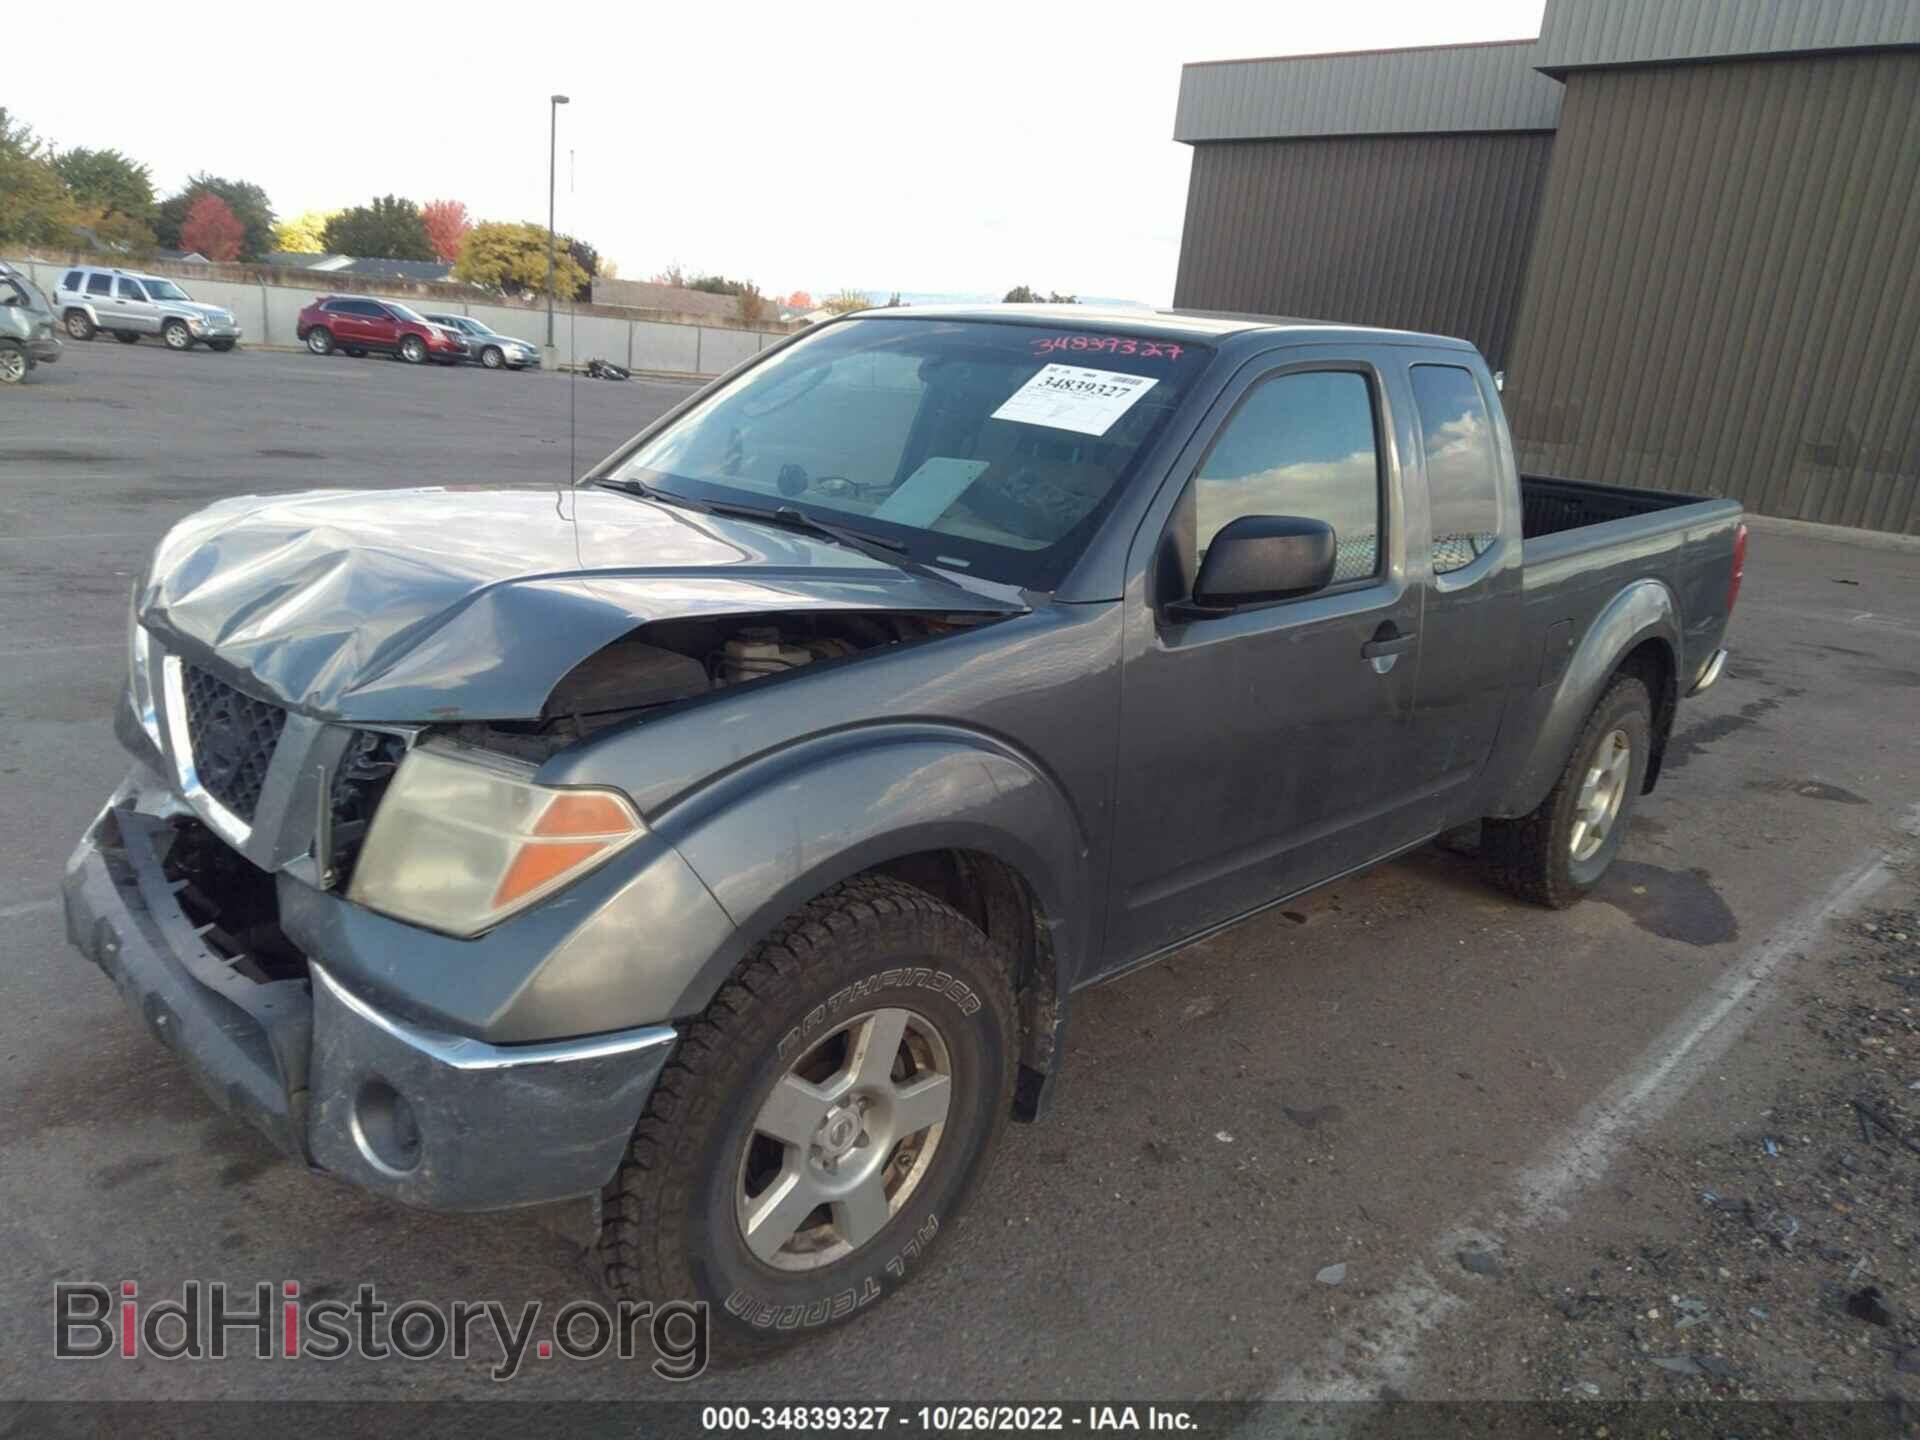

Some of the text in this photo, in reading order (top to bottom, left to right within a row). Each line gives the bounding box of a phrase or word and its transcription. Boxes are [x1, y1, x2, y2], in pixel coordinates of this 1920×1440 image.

[1030, 336, 1184, 360] 34839327
[1038, 377, 1131, 398] 34839327
[777, 967, 982, 1060] PATHFINDER
[724, 1214, 939, 1329] ALL TERRAIN
